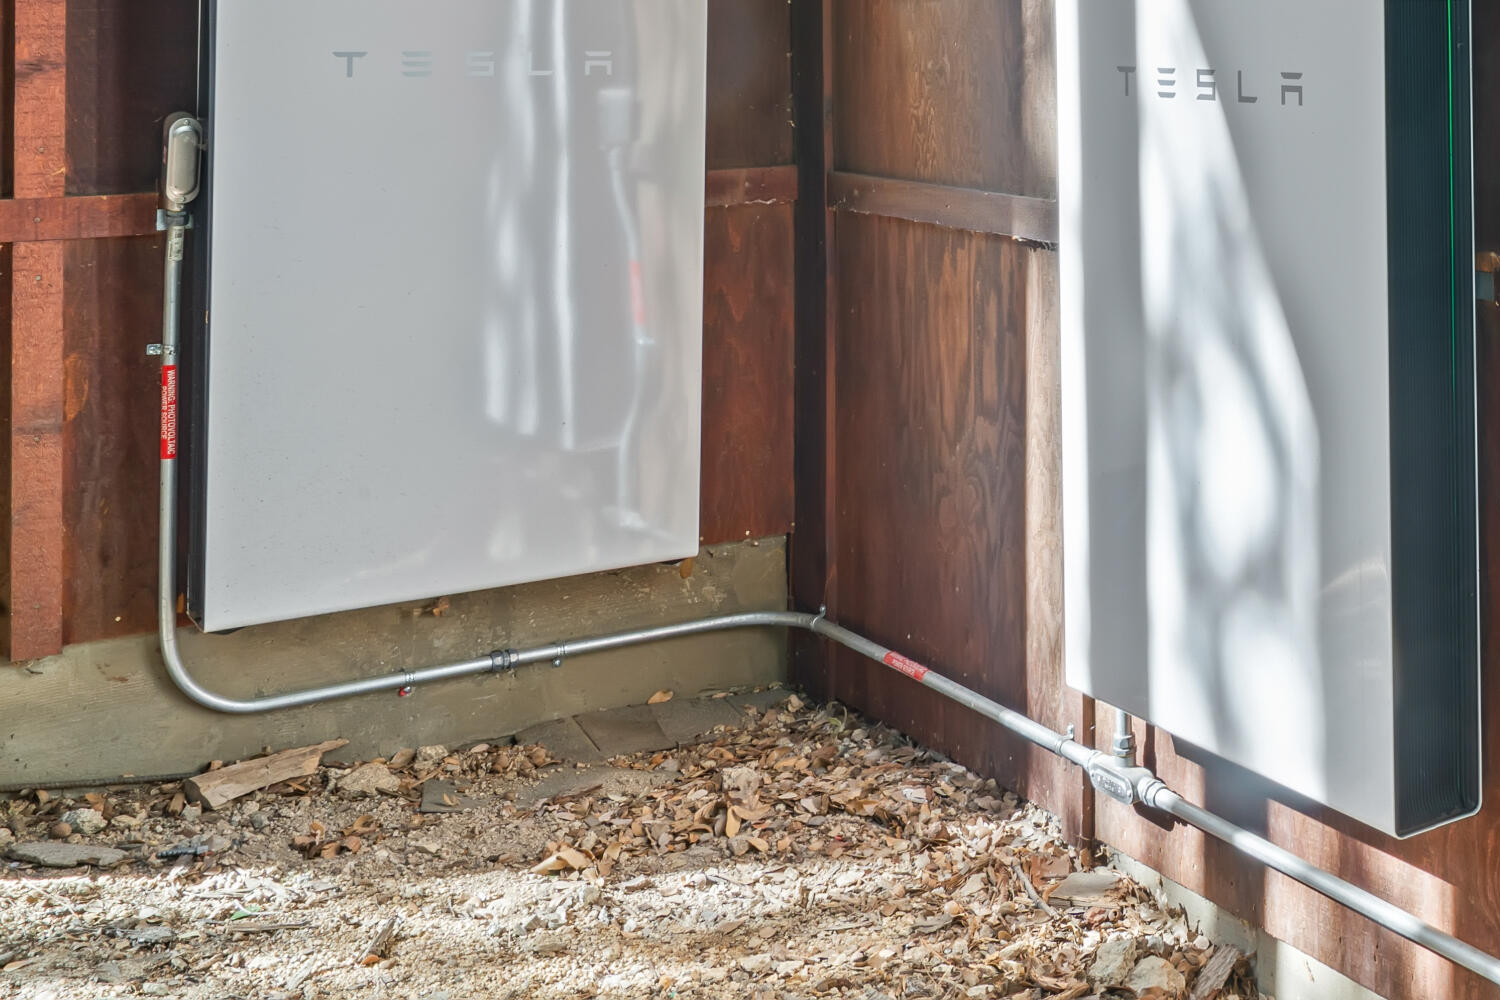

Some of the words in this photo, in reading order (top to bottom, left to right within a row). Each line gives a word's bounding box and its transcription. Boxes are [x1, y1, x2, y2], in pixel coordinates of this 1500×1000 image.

[332, 51, 612, 78] TESLA
[1117, 66, 1303, 106] TESLA
[167, 370, 176, 403] WARNING:
[167, 404, 176, 455] PHOTOVOLTAIC
